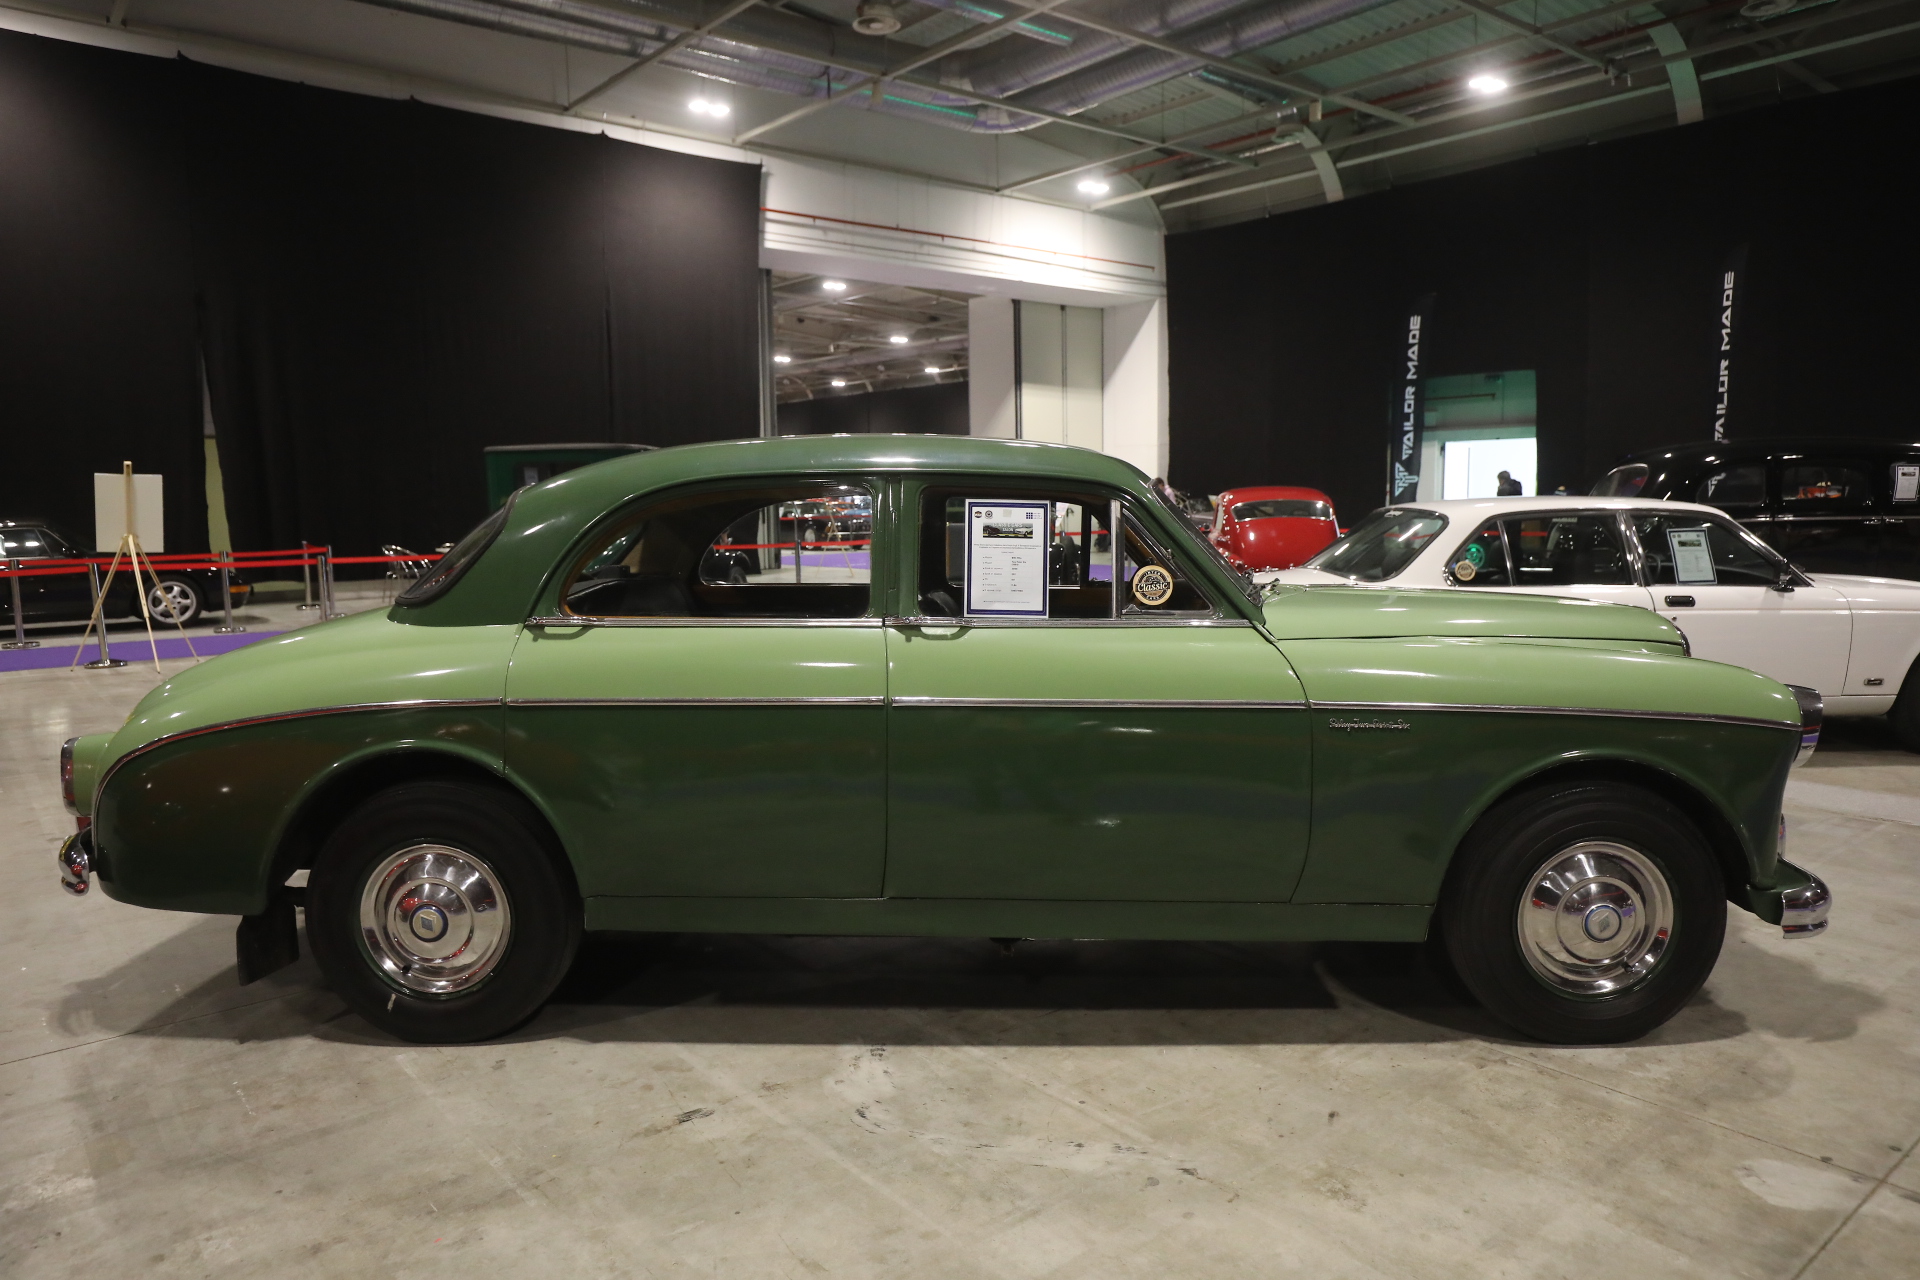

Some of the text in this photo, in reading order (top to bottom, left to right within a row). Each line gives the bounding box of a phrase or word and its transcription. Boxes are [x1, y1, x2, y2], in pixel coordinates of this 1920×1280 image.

[1721, 271, 1734, 351] MADE
[1402, 314, 1421, 461] TAILOR MADE
[1137, 581, 1168, 592] Classic
